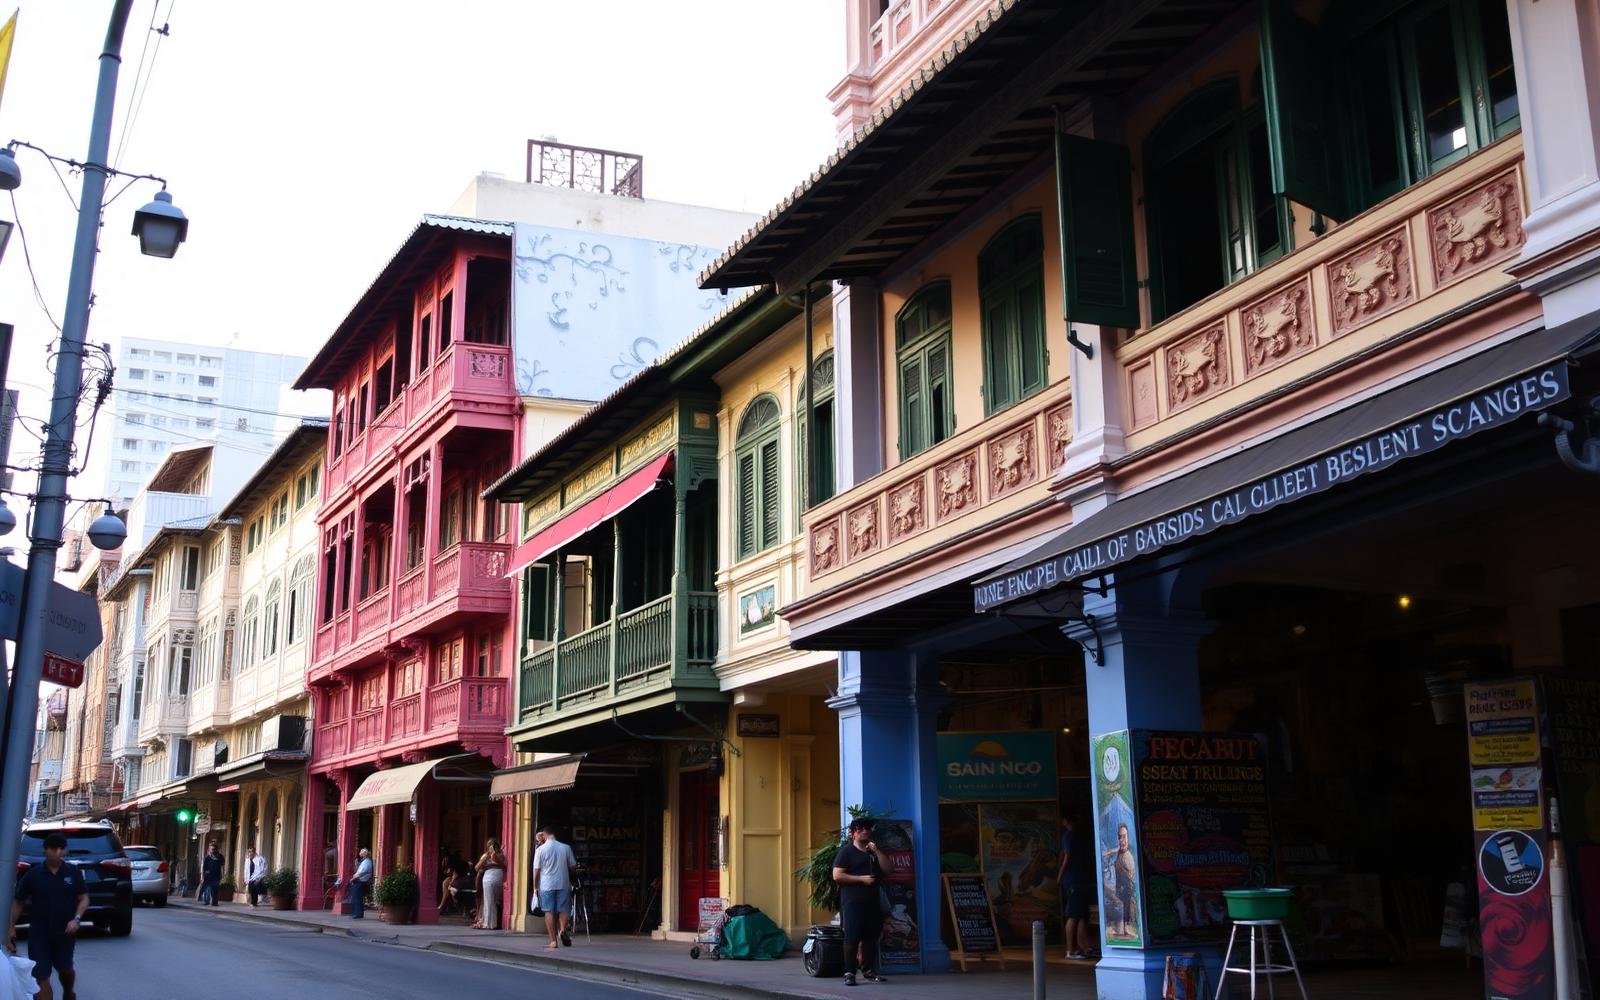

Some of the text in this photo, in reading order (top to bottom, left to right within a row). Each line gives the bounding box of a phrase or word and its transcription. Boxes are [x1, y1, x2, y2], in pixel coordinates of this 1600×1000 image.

[1108, 534, 1128, 560] OF
[1211, 494, 1247, 523] CAL
[1326, 423, 1423, 482] BESLENT
[1432, 370, 1559, 442] SCANGES
